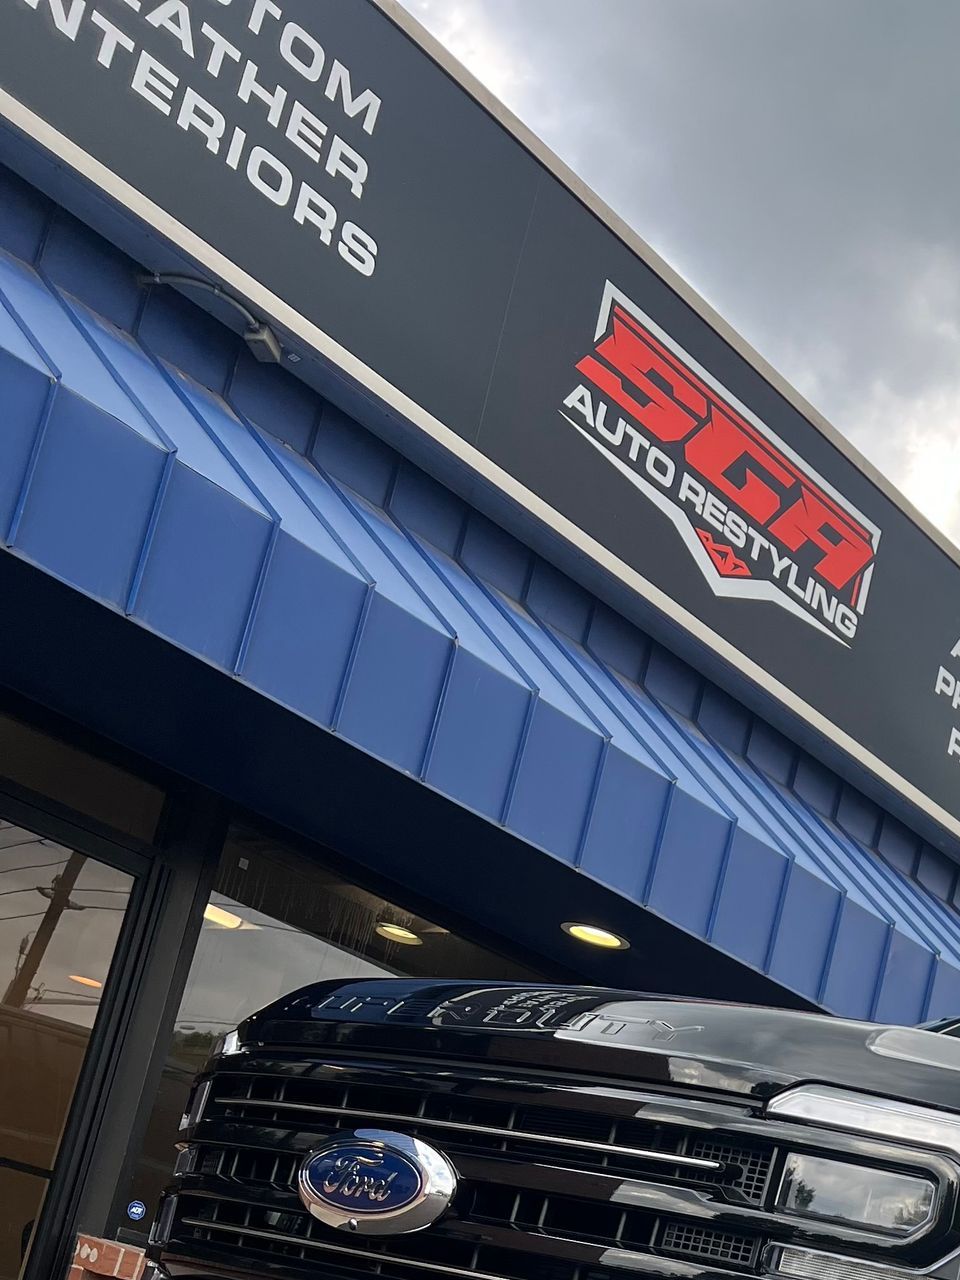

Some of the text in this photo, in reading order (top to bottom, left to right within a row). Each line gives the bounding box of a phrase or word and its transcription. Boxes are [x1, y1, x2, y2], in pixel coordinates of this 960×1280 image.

[125, 0, 369, 199] ATHER
[220, 0, 382, 135] TOM
[562, 384, 858, 638] AUTO RESTYLING
[322, 1154, 398, 1202] Ford
